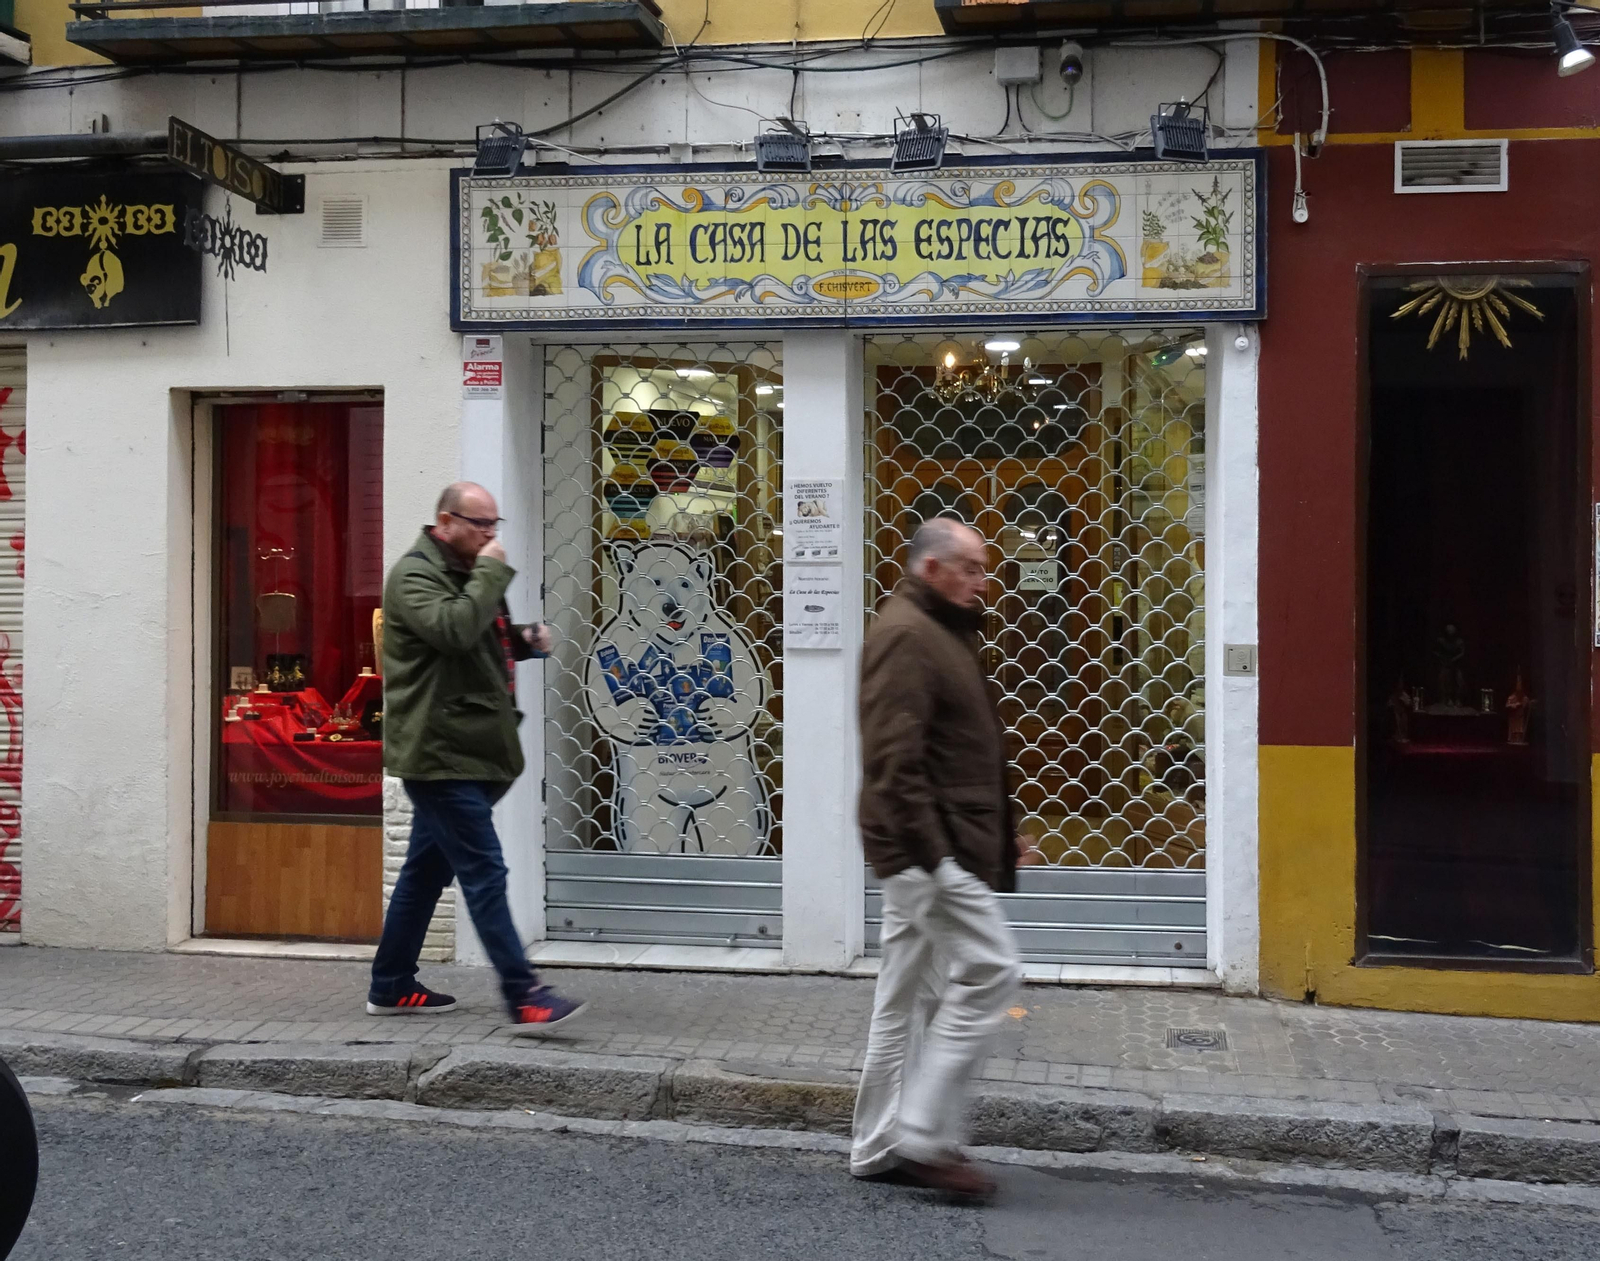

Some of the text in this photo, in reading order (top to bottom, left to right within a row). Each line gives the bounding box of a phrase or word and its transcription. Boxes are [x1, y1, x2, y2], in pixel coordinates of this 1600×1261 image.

[172, 122, 281, 207] EL TOISON
[635, 216, 1071, 266] LA CASA DE LAS ESPECIAS
[467, 362, 500, 371] Alarma
[656, 417, 691, 428] NUEVO
[229, 768, 383, 788] www.joyeriaeltoison.co
